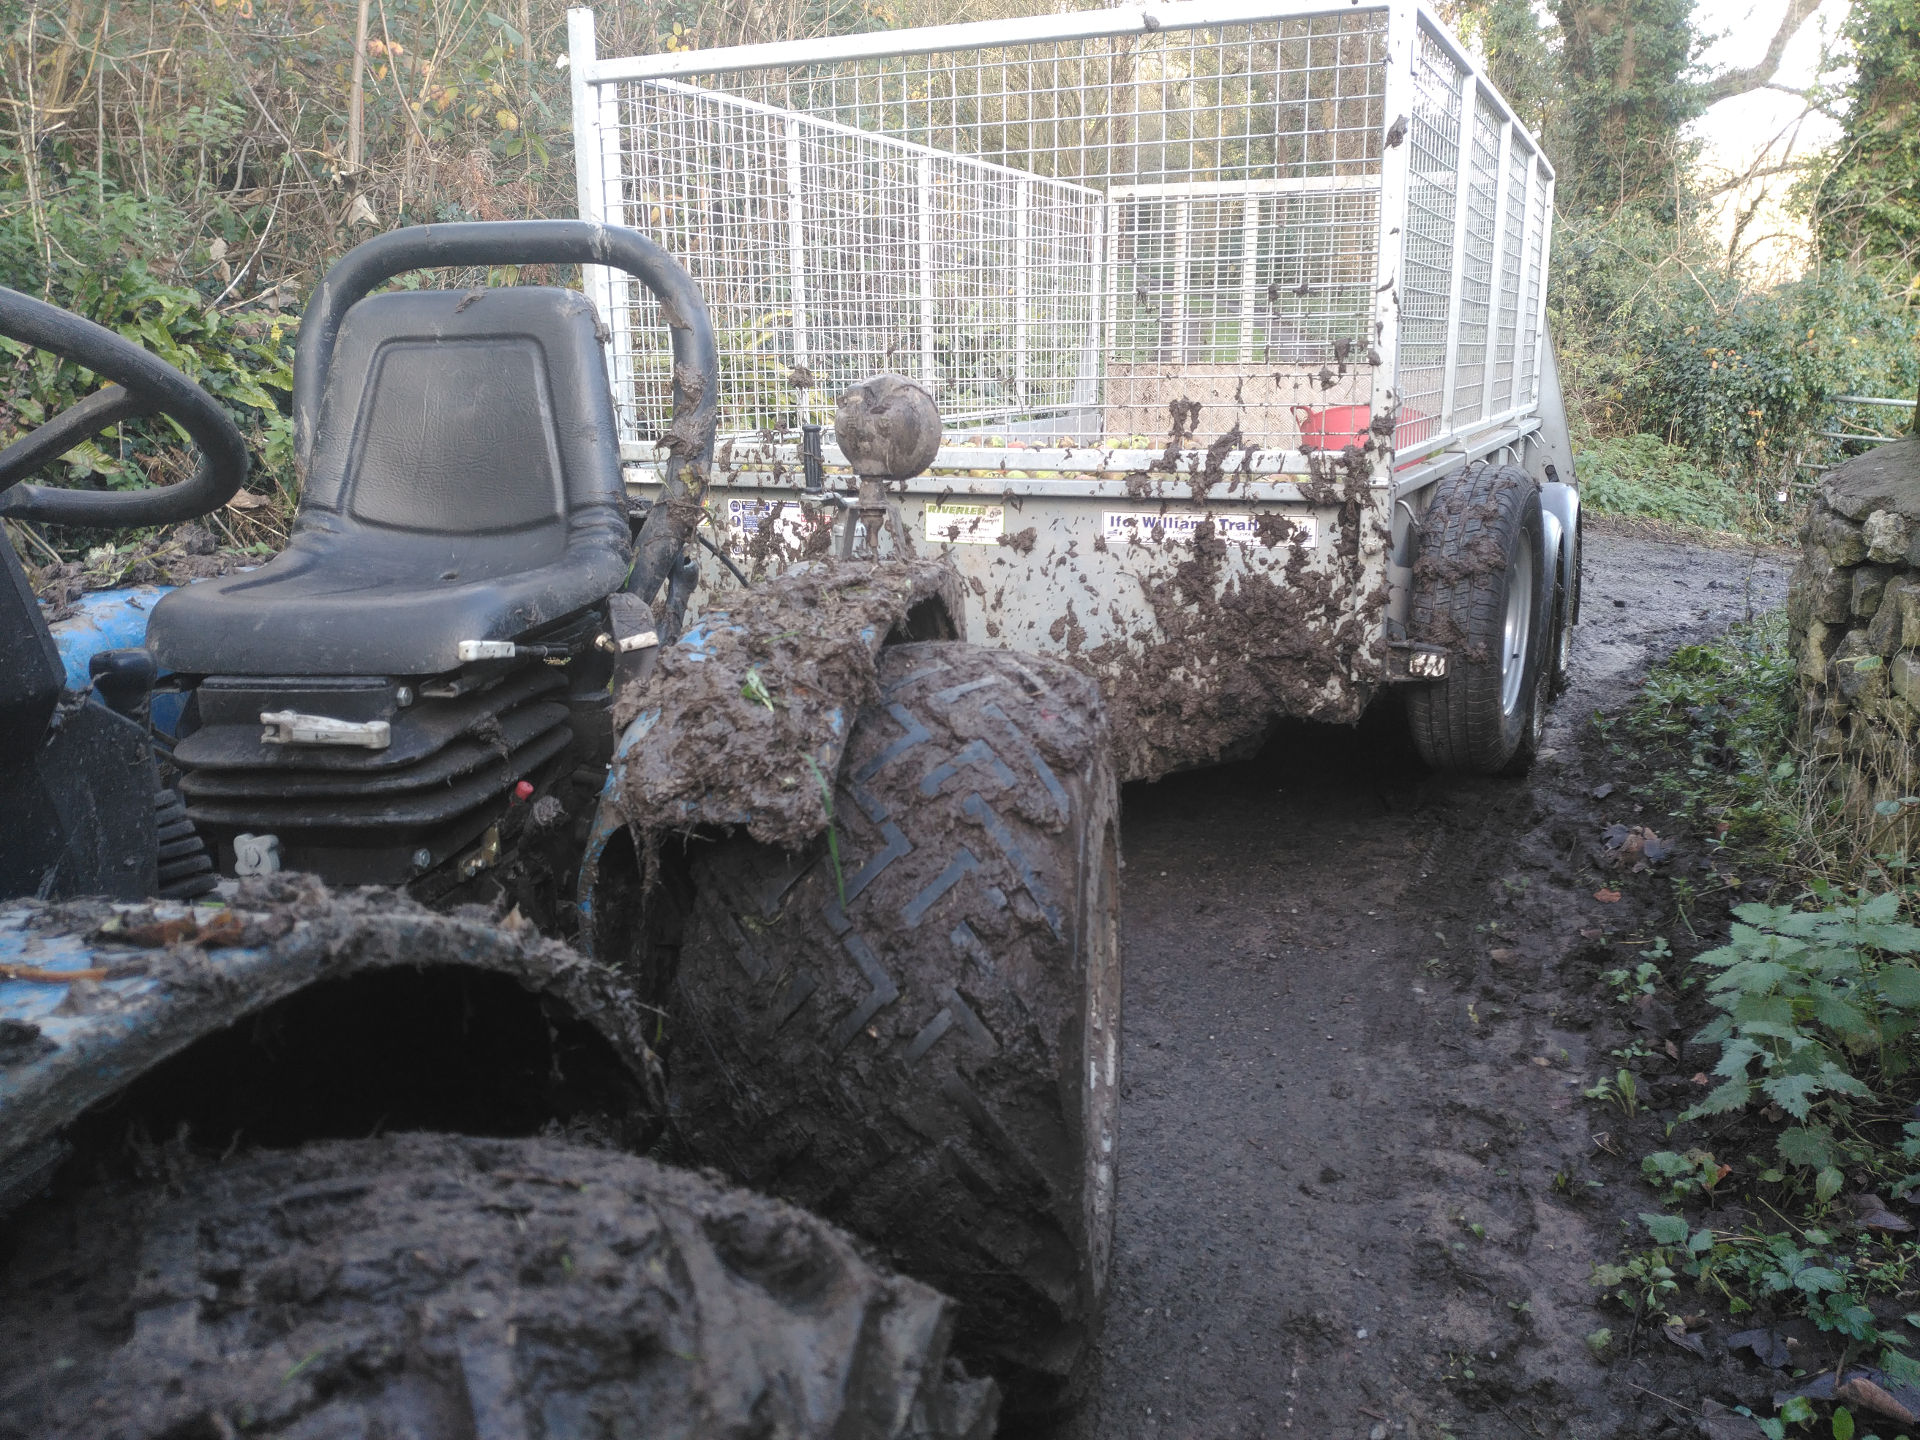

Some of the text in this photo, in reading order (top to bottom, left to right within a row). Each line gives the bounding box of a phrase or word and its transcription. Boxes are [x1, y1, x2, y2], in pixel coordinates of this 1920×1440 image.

[927, 505, 986, 515] RIVERLEA
[1110, 515, 1137, 527] Ifo
[1142, 516, 1213, 529] William
